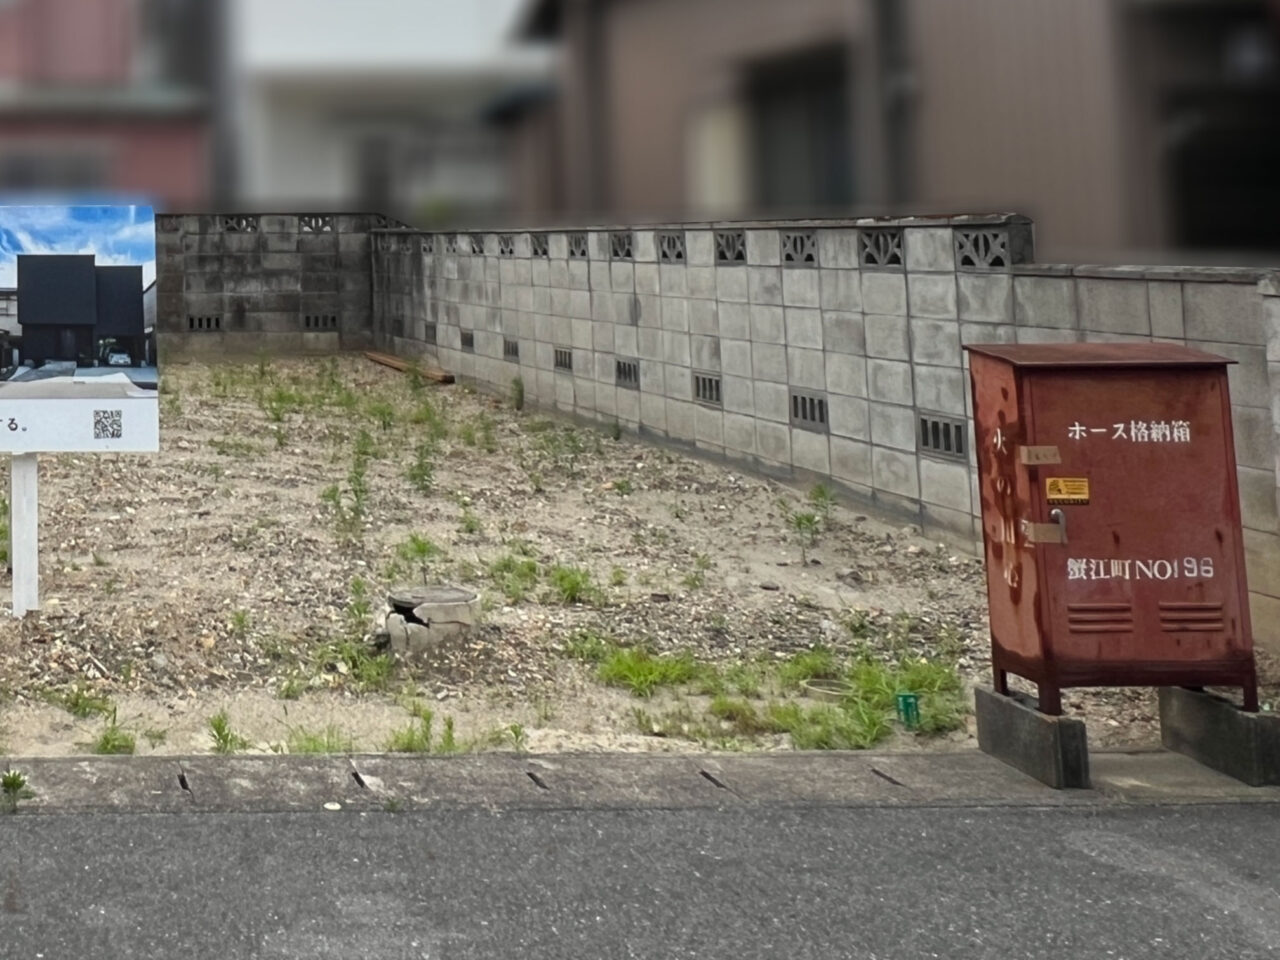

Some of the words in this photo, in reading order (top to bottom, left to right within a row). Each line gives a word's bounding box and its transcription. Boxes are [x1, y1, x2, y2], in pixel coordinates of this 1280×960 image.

[1067, 419, 1191, 443] ホース格納箱
